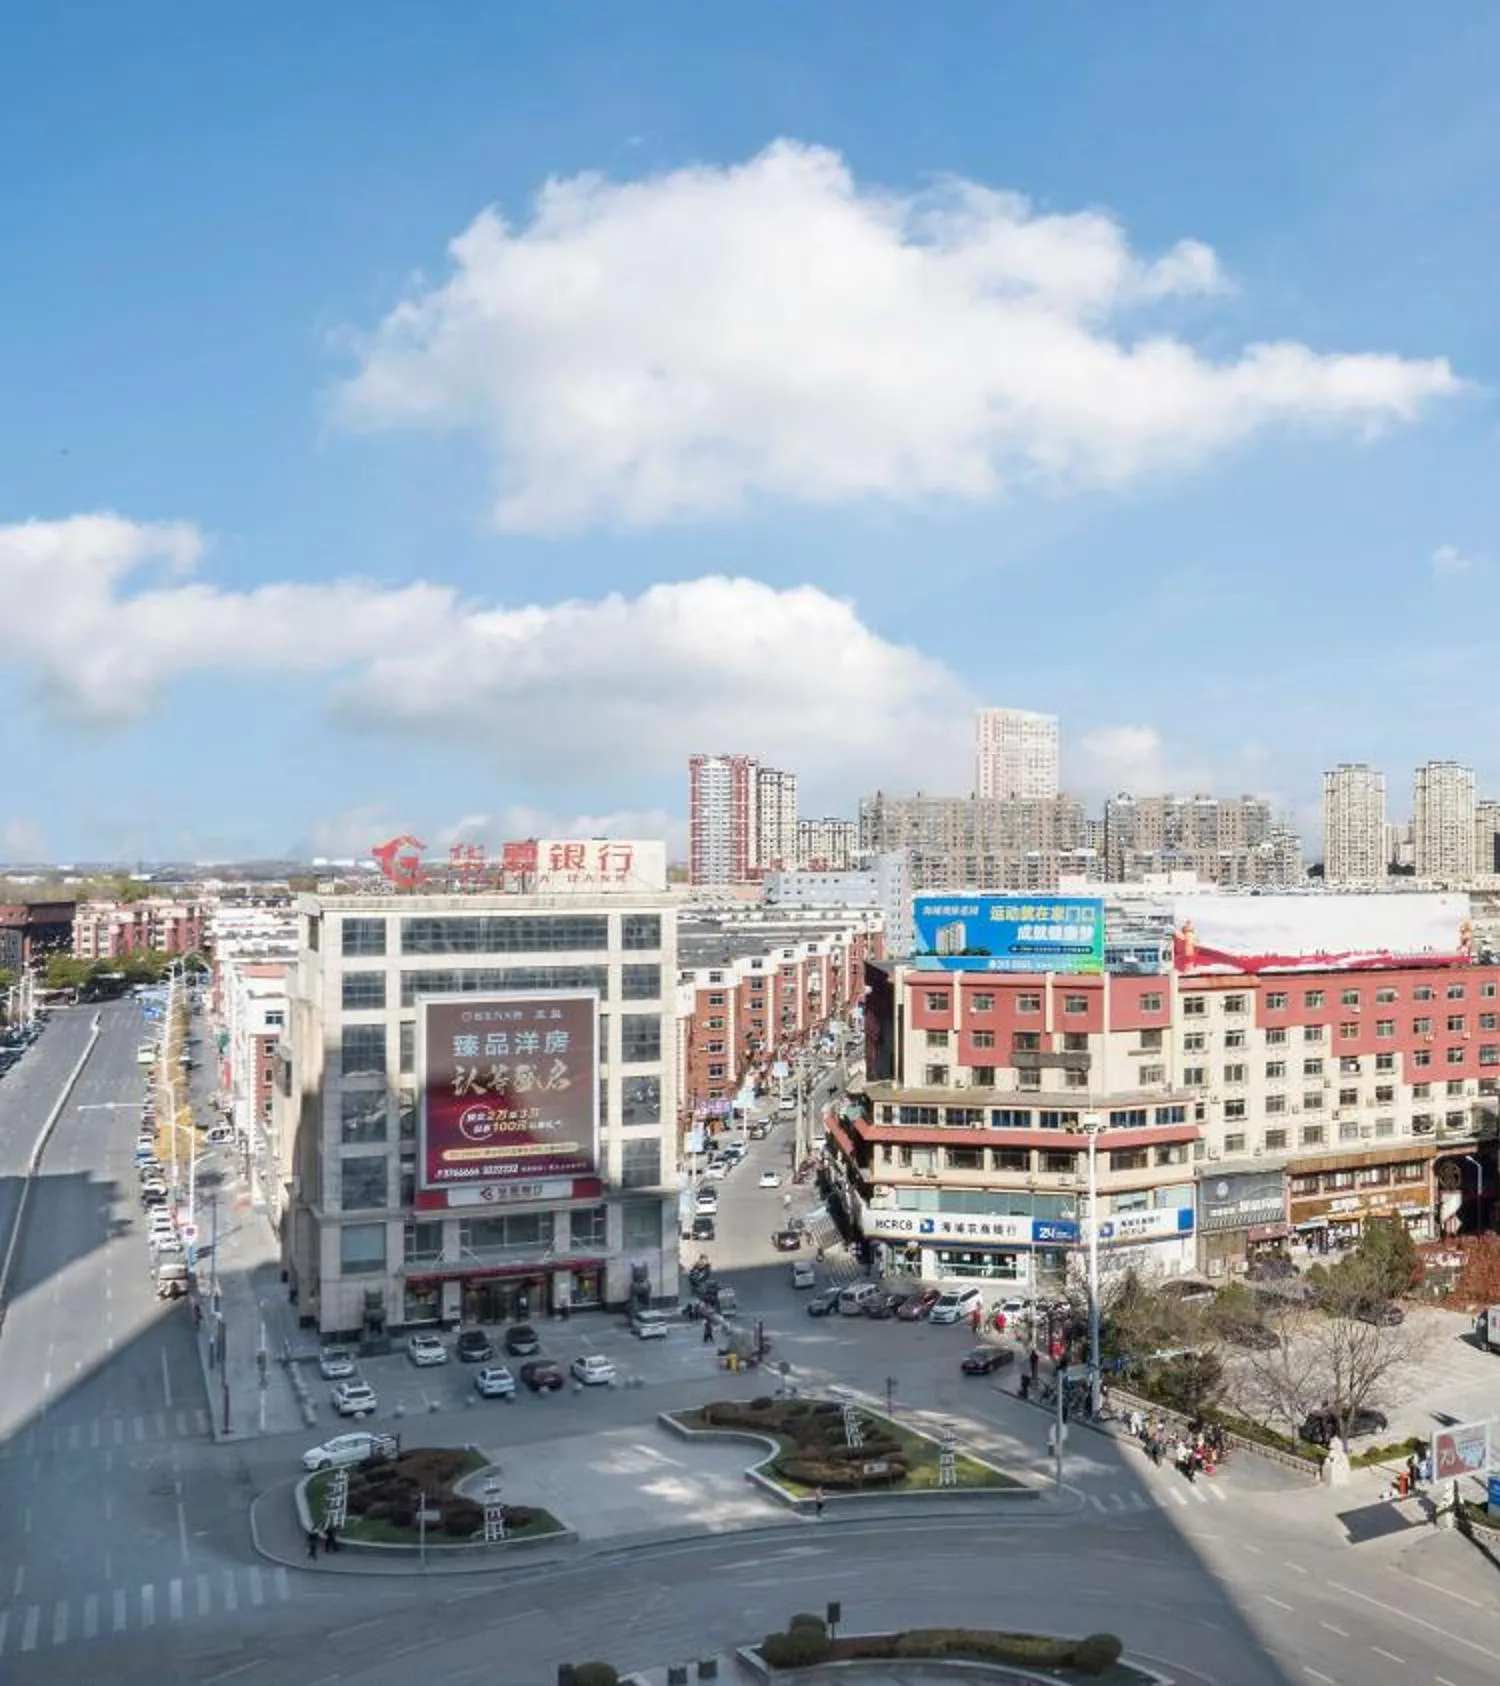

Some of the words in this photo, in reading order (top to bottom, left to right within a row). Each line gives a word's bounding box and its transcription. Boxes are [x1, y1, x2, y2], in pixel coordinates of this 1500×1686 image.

[449, 842, 633, 886] 华夏银行
[452, 1030, 571, 1057] 臻品洋房
[875, 1218, 913, 1230] HCRCB
